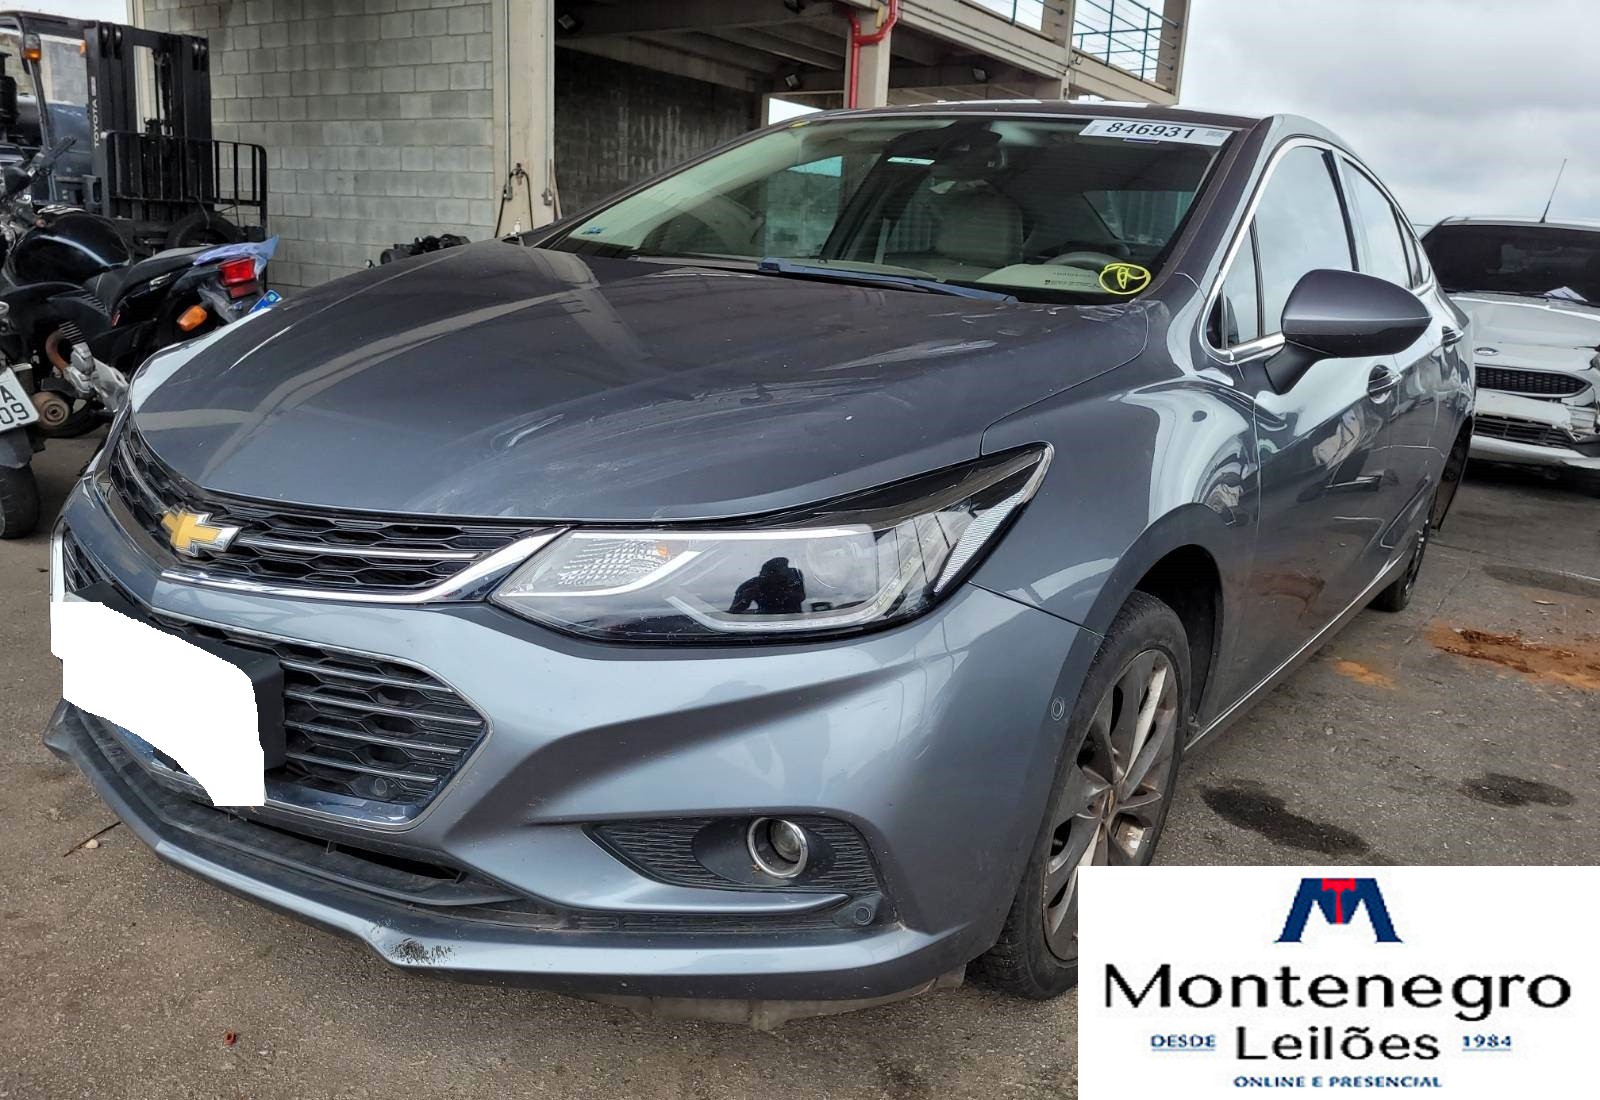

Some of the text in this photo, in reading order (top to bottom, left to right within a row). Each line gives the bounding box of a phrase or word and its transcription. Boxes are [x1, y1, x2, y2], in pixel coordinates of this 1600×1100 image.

[91, 99, 100, 149] TOYOTA
[1106, 122, 1196, 139] 846931
[0, 385, 17, 403] A
